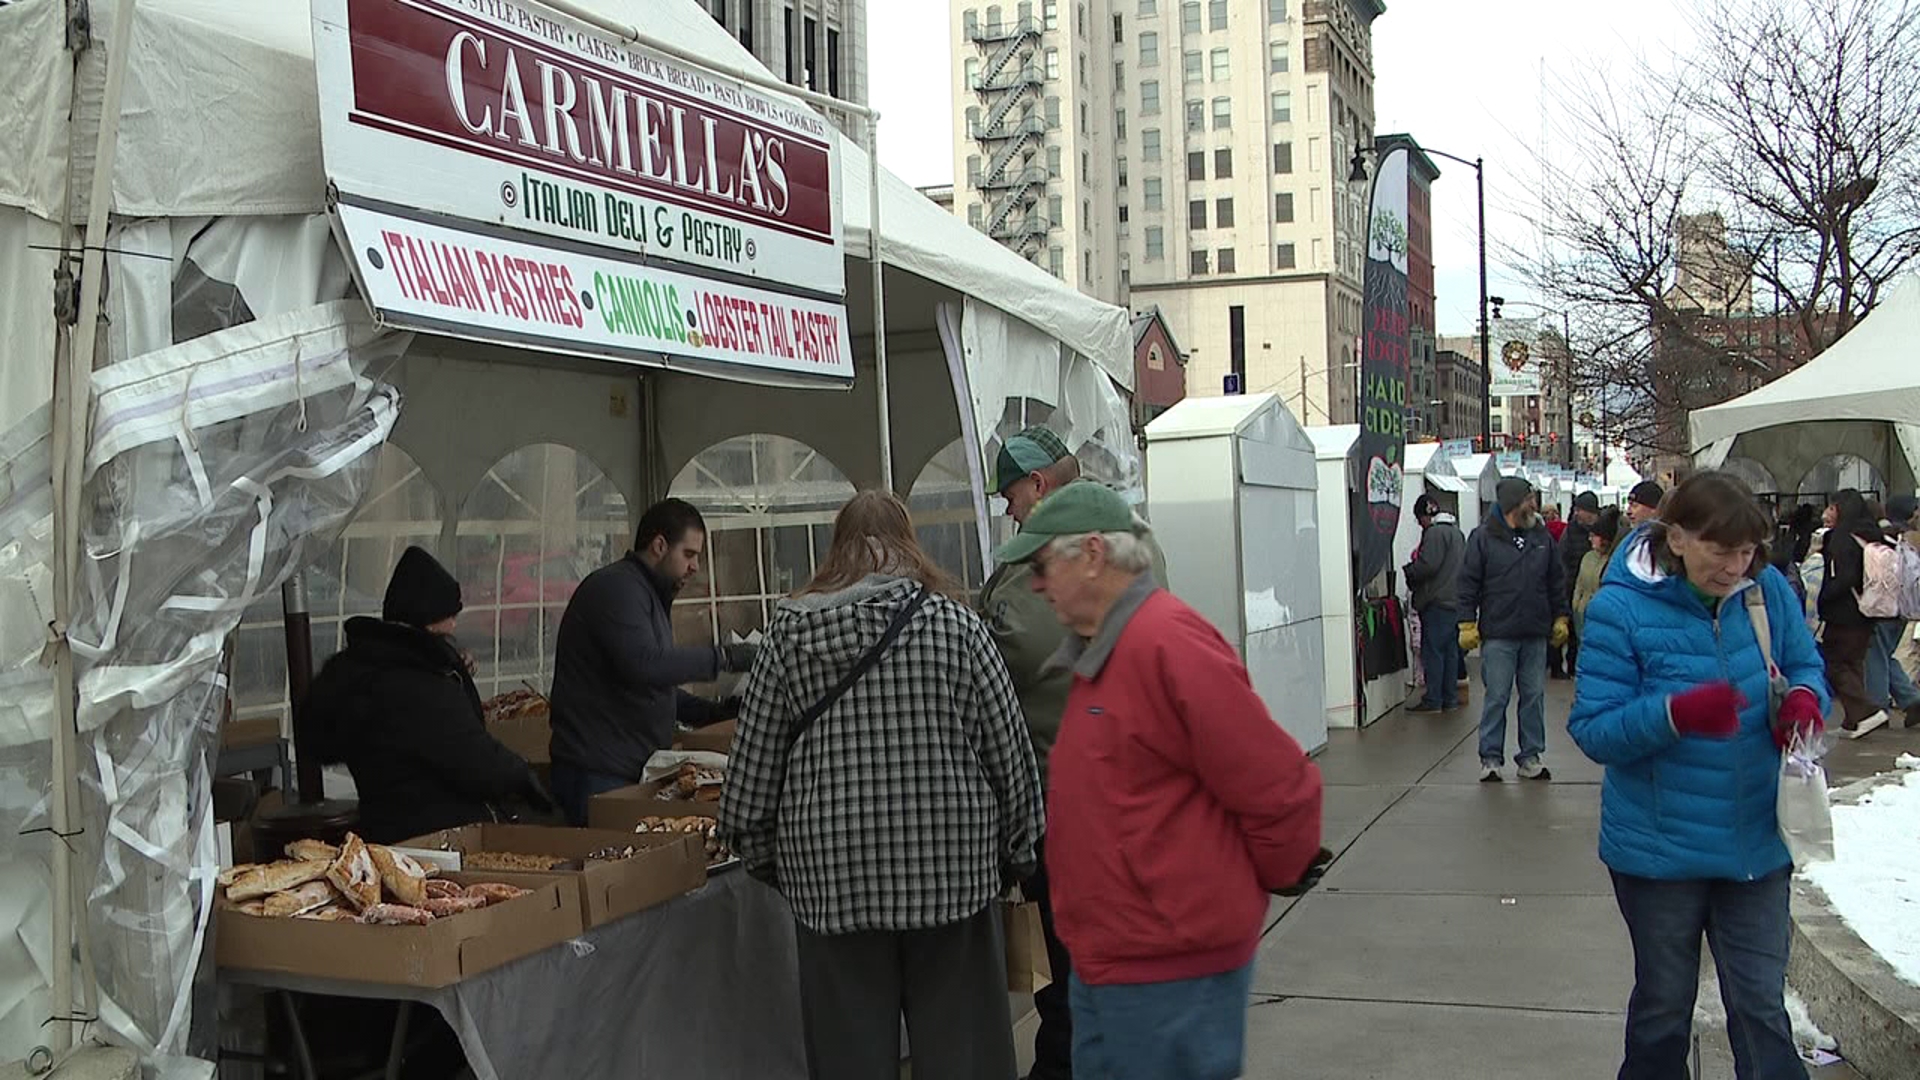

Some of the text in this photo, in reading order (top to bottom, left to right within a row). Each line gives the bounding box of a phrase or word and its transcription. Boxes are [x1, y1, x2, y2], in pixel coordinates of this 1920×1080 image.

[444, 29, 790, 218] CARMELLA'S
[518, 8, 567, 45] PASTRY
[576, 32, 619, 65] CAKES
[628, 51, 665, 80] BRICK
[667, 66, 706, 94] BREAD
[713, 82, 744, 108] PASTA
[745, 95, 779, 120] BOWLS
[783, 108, 825, 137] COOKIES
[521, 172, 743, 264] ITALIAN DELI & PASTRY
[381, 229, 841, 365] ITALIAN PASTRIES CANNOLIS LOBSTER TAIL PASTRY
[1366, 372, 1406, 407] HARD
